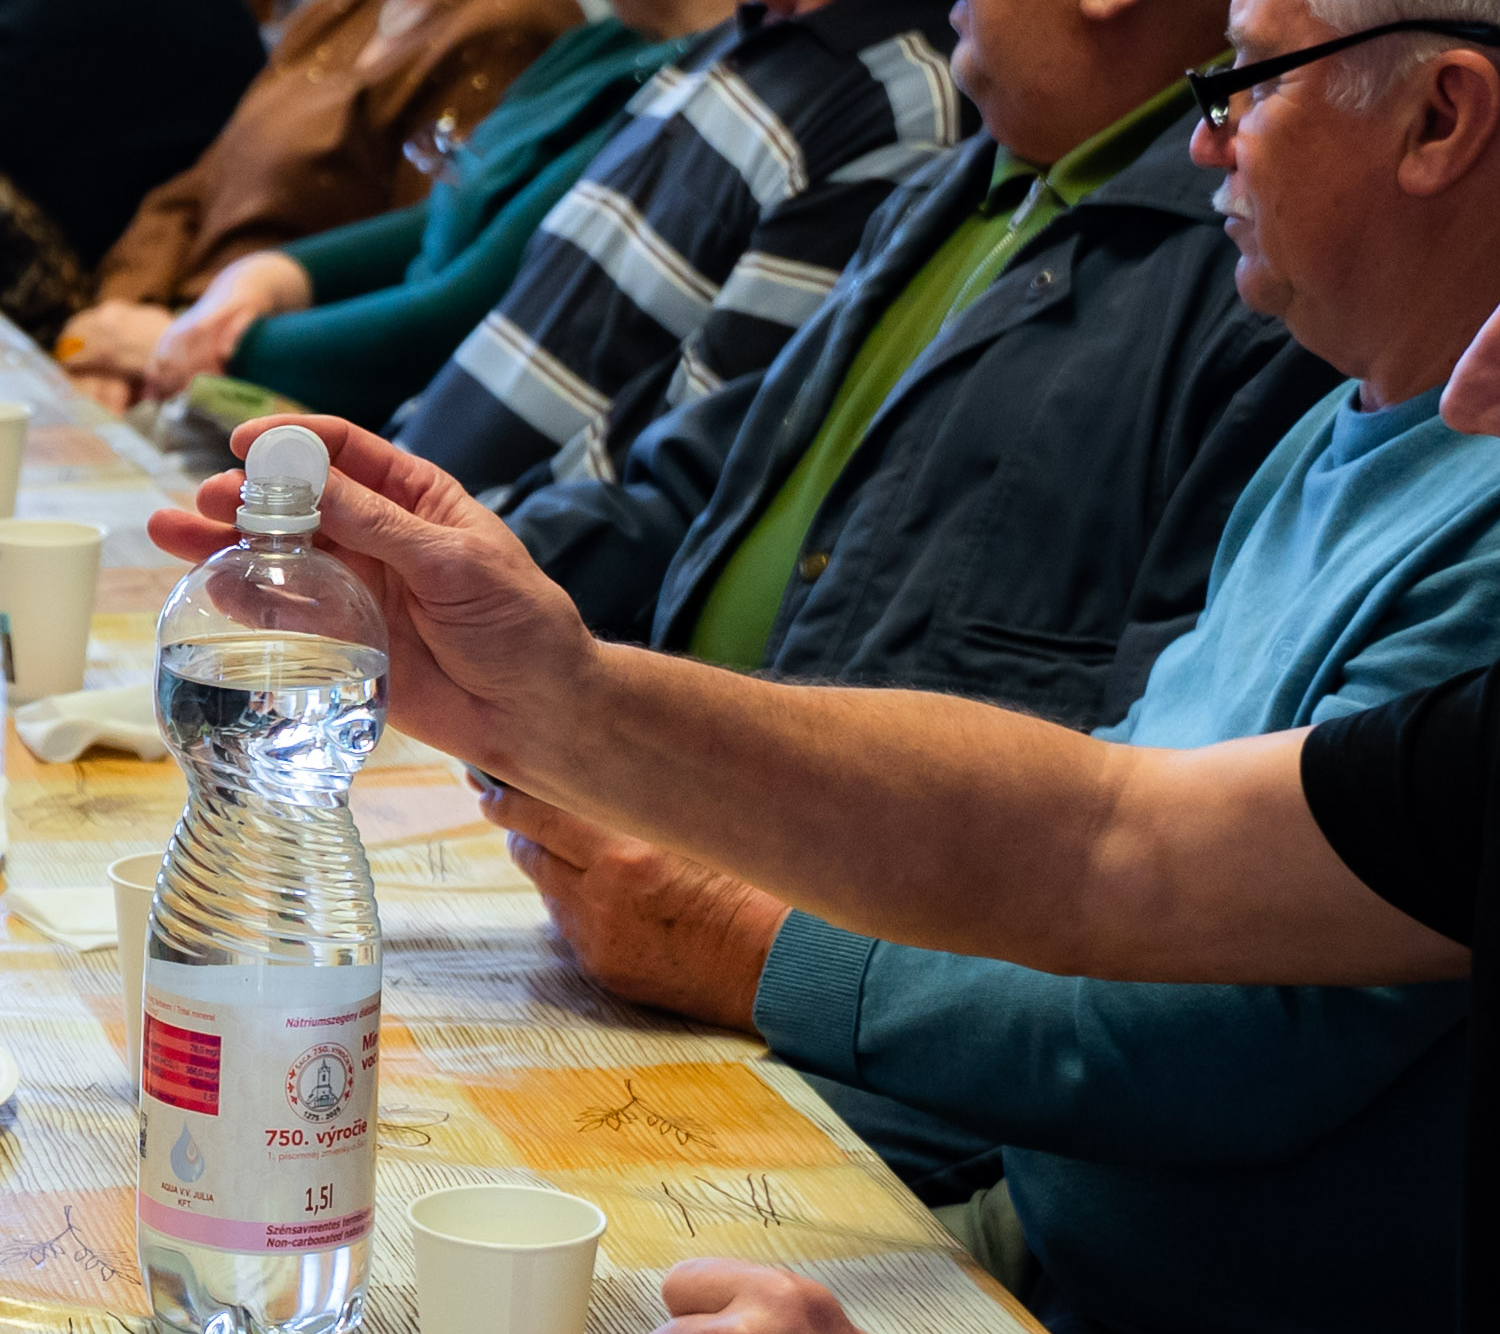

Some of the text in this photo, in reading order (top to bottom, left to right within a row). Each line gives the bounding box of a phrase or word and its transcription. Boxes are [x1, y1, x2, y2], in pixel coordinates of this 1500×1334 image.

[265, 1119, 367, 1147] 750. výročie
[265, 1221, 341, 1236] Szénsavmentes
[265, 1231, 343, 1248] Non-carbonated
